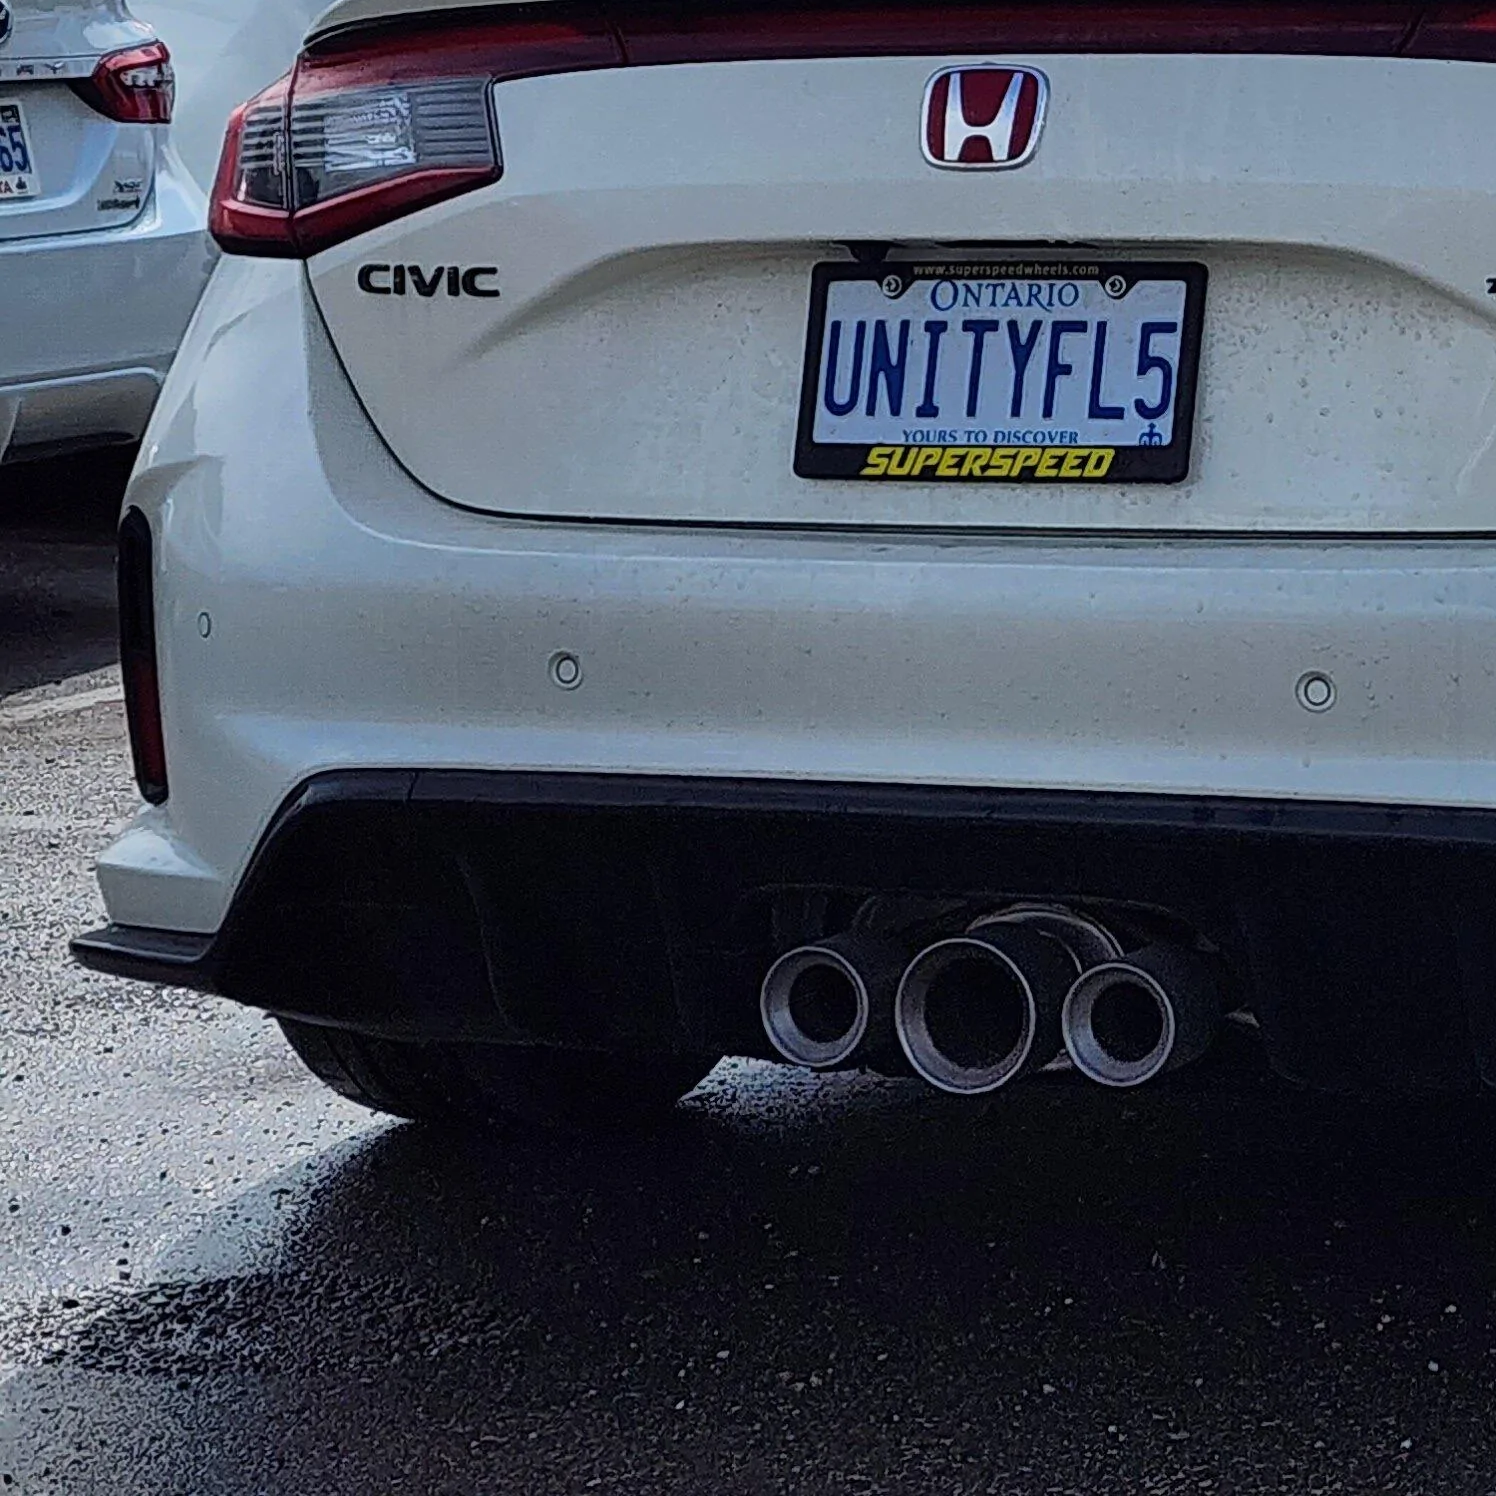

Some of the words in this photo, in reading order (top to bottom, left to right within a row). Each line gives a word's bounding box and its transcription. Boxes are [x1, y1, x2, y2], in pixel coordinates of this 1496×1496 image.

[357, 264, 500, 297] CIVIC
[913, 264, 1100, 277] www.superspeedwheels.com
[930, 279, 1080, 312] ONTARIO
[824, 319, 1178, 420] UNITYFL5
[902, 429, 958, 444] YOURS
[964, 429, 988, 444] TO
[993, 430, 1079, 444] DISCOVER
[859, 446, 1116, 478] SUPERSPEED
